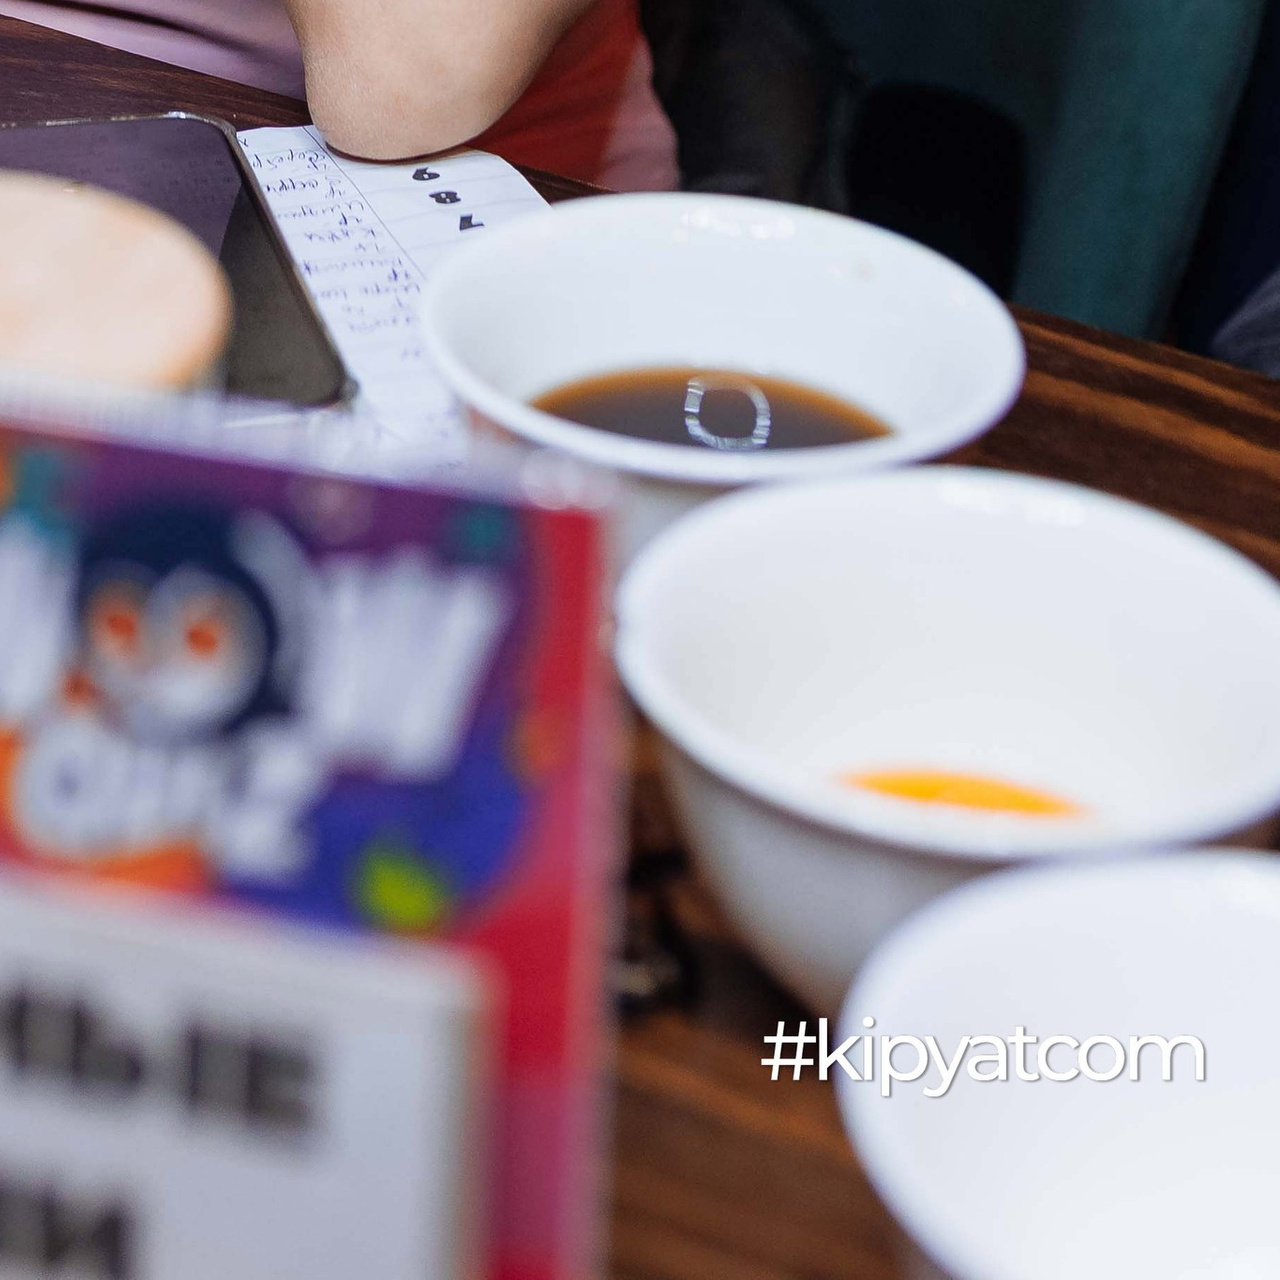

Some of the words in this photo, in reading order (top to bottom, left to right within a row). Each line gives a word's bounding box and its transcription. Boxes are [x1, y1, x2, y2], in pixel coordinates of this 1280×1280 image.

[412, 167, 440, 180] 9
[429, 191, 461, 204] 8
[459, 214, 485, 231] 7
